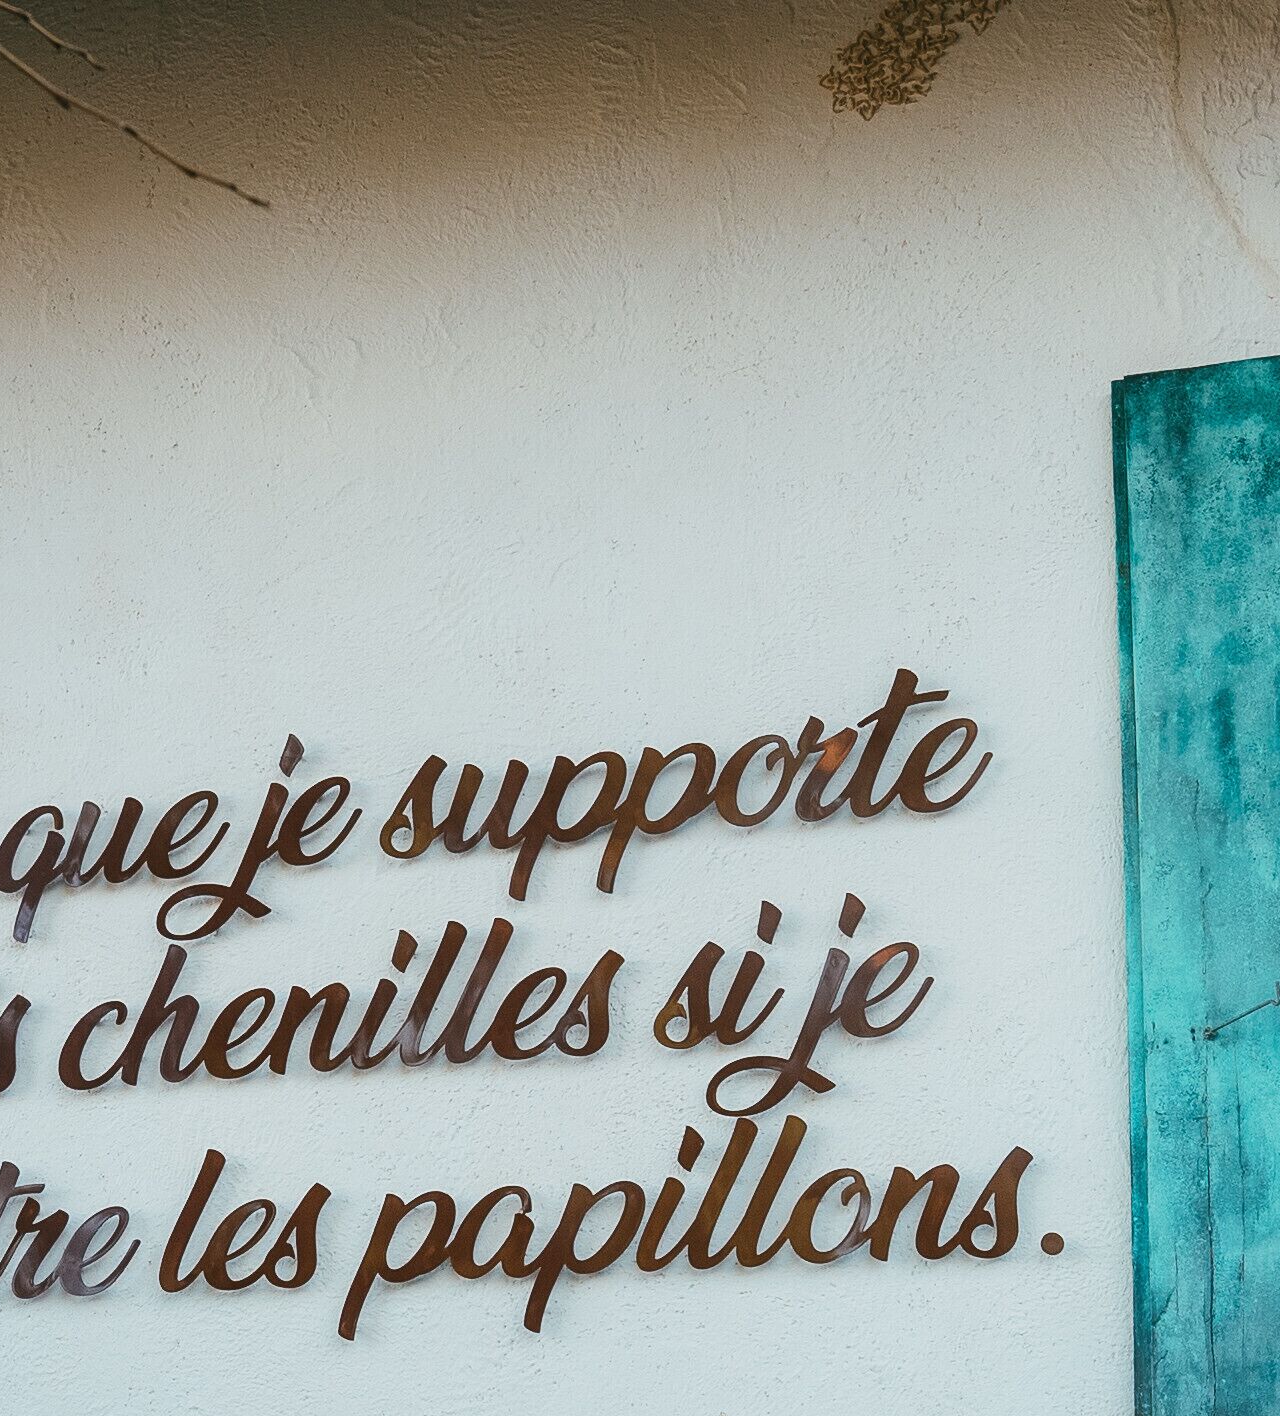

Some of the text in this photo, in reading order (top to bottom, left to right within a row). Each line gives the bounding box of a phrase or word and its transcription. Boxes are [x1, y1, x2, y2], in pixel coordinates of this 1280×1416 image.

[156, 733, 362, 940] je
[380, 668, 993, 901] supporte
[59, 917, 624, 1091] chenilles
[653, 900, 785, 1050] si
[706, 892, 934, 1116] je
[158, 1149, 332, 1293] les
[337, 1114, 1065, 1341] papillons.
